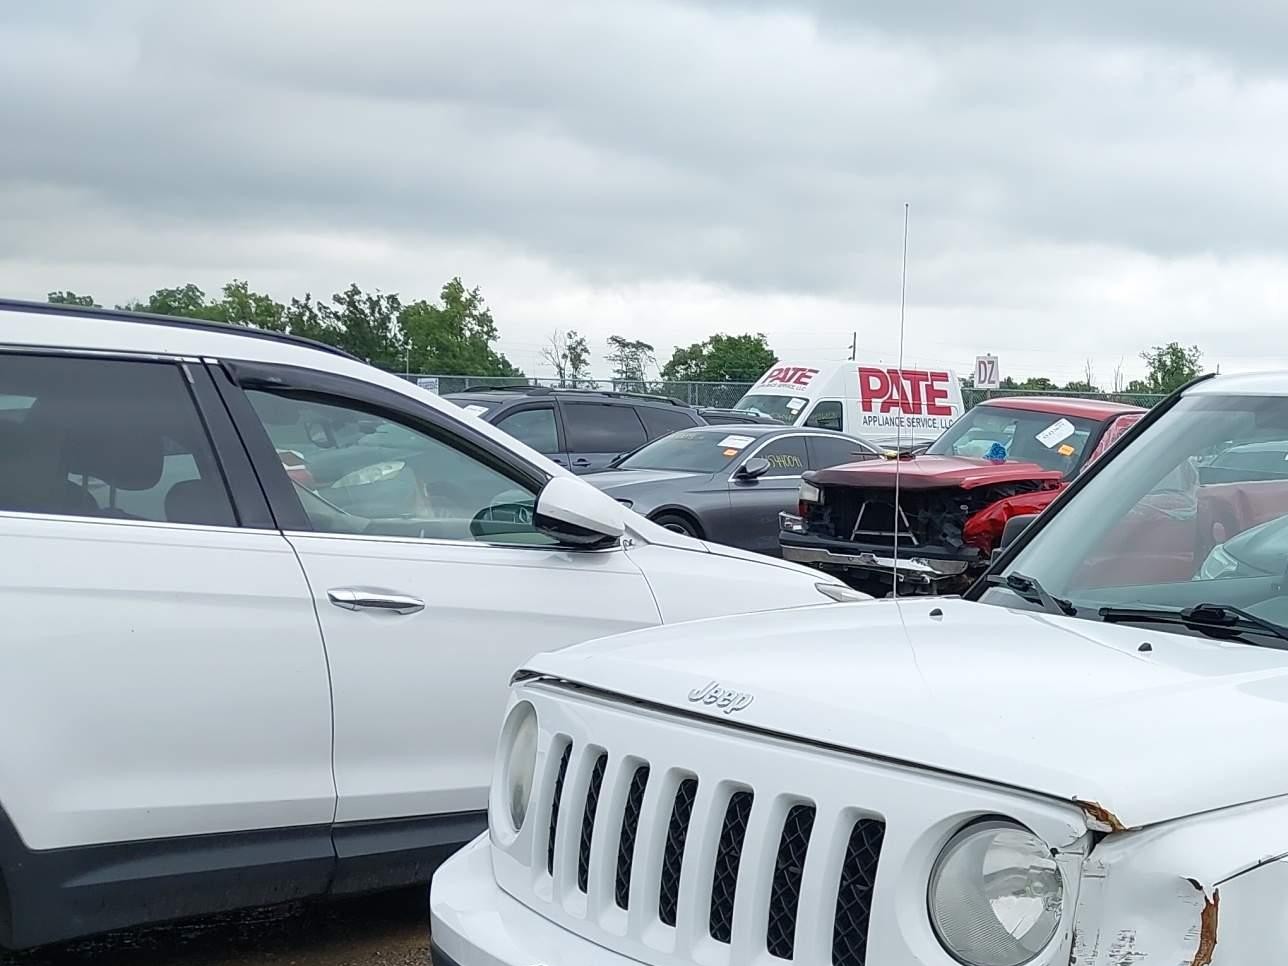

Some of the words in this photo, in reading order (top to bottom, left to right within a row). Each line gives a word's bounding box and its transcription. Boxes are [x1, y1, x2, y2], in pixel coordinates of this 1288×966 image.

[762, 367, 819, 386] PATE
[978, 360, 996, 385] DZ
[858, 367, 952, 416] PATE
[862, 416, 905, 428] APPLIANCE
[905, 417, 938, 430] SERVICE,
[688, 680, 754, 715] Jeep
